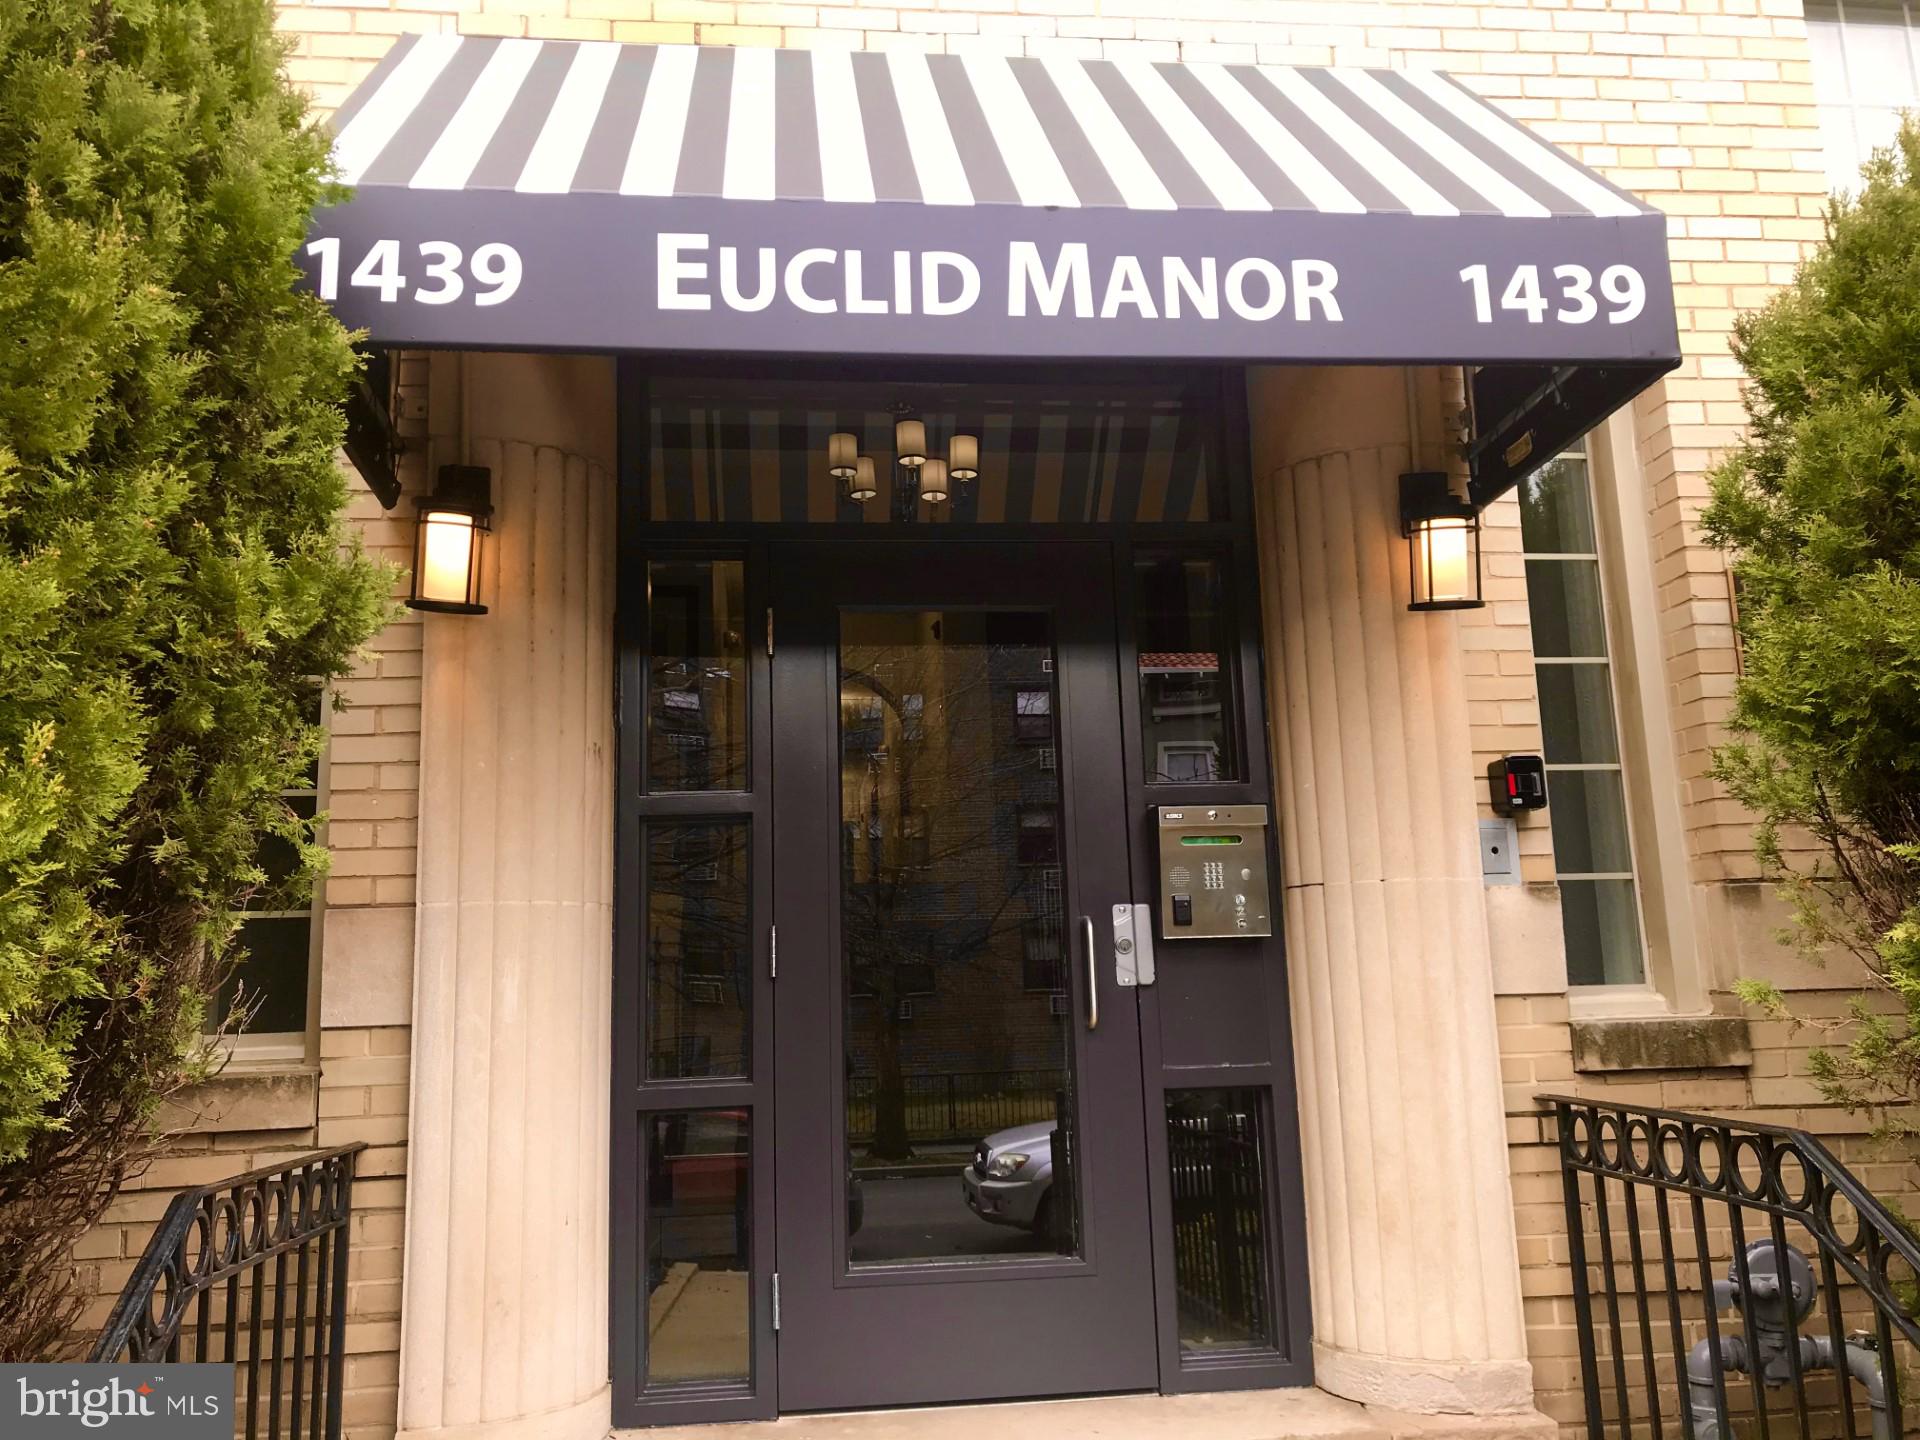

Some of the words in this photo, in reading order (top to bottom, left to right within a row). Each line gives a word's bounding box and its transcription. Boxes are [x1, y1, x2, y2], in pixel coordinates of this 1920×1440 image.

[305, 236, 524, 307] 1439
[655, 232, 982, 316] EUCLID
[1006, 240, 1345, 323] MANOR
[1458, 263, 1648, 326] 1439
